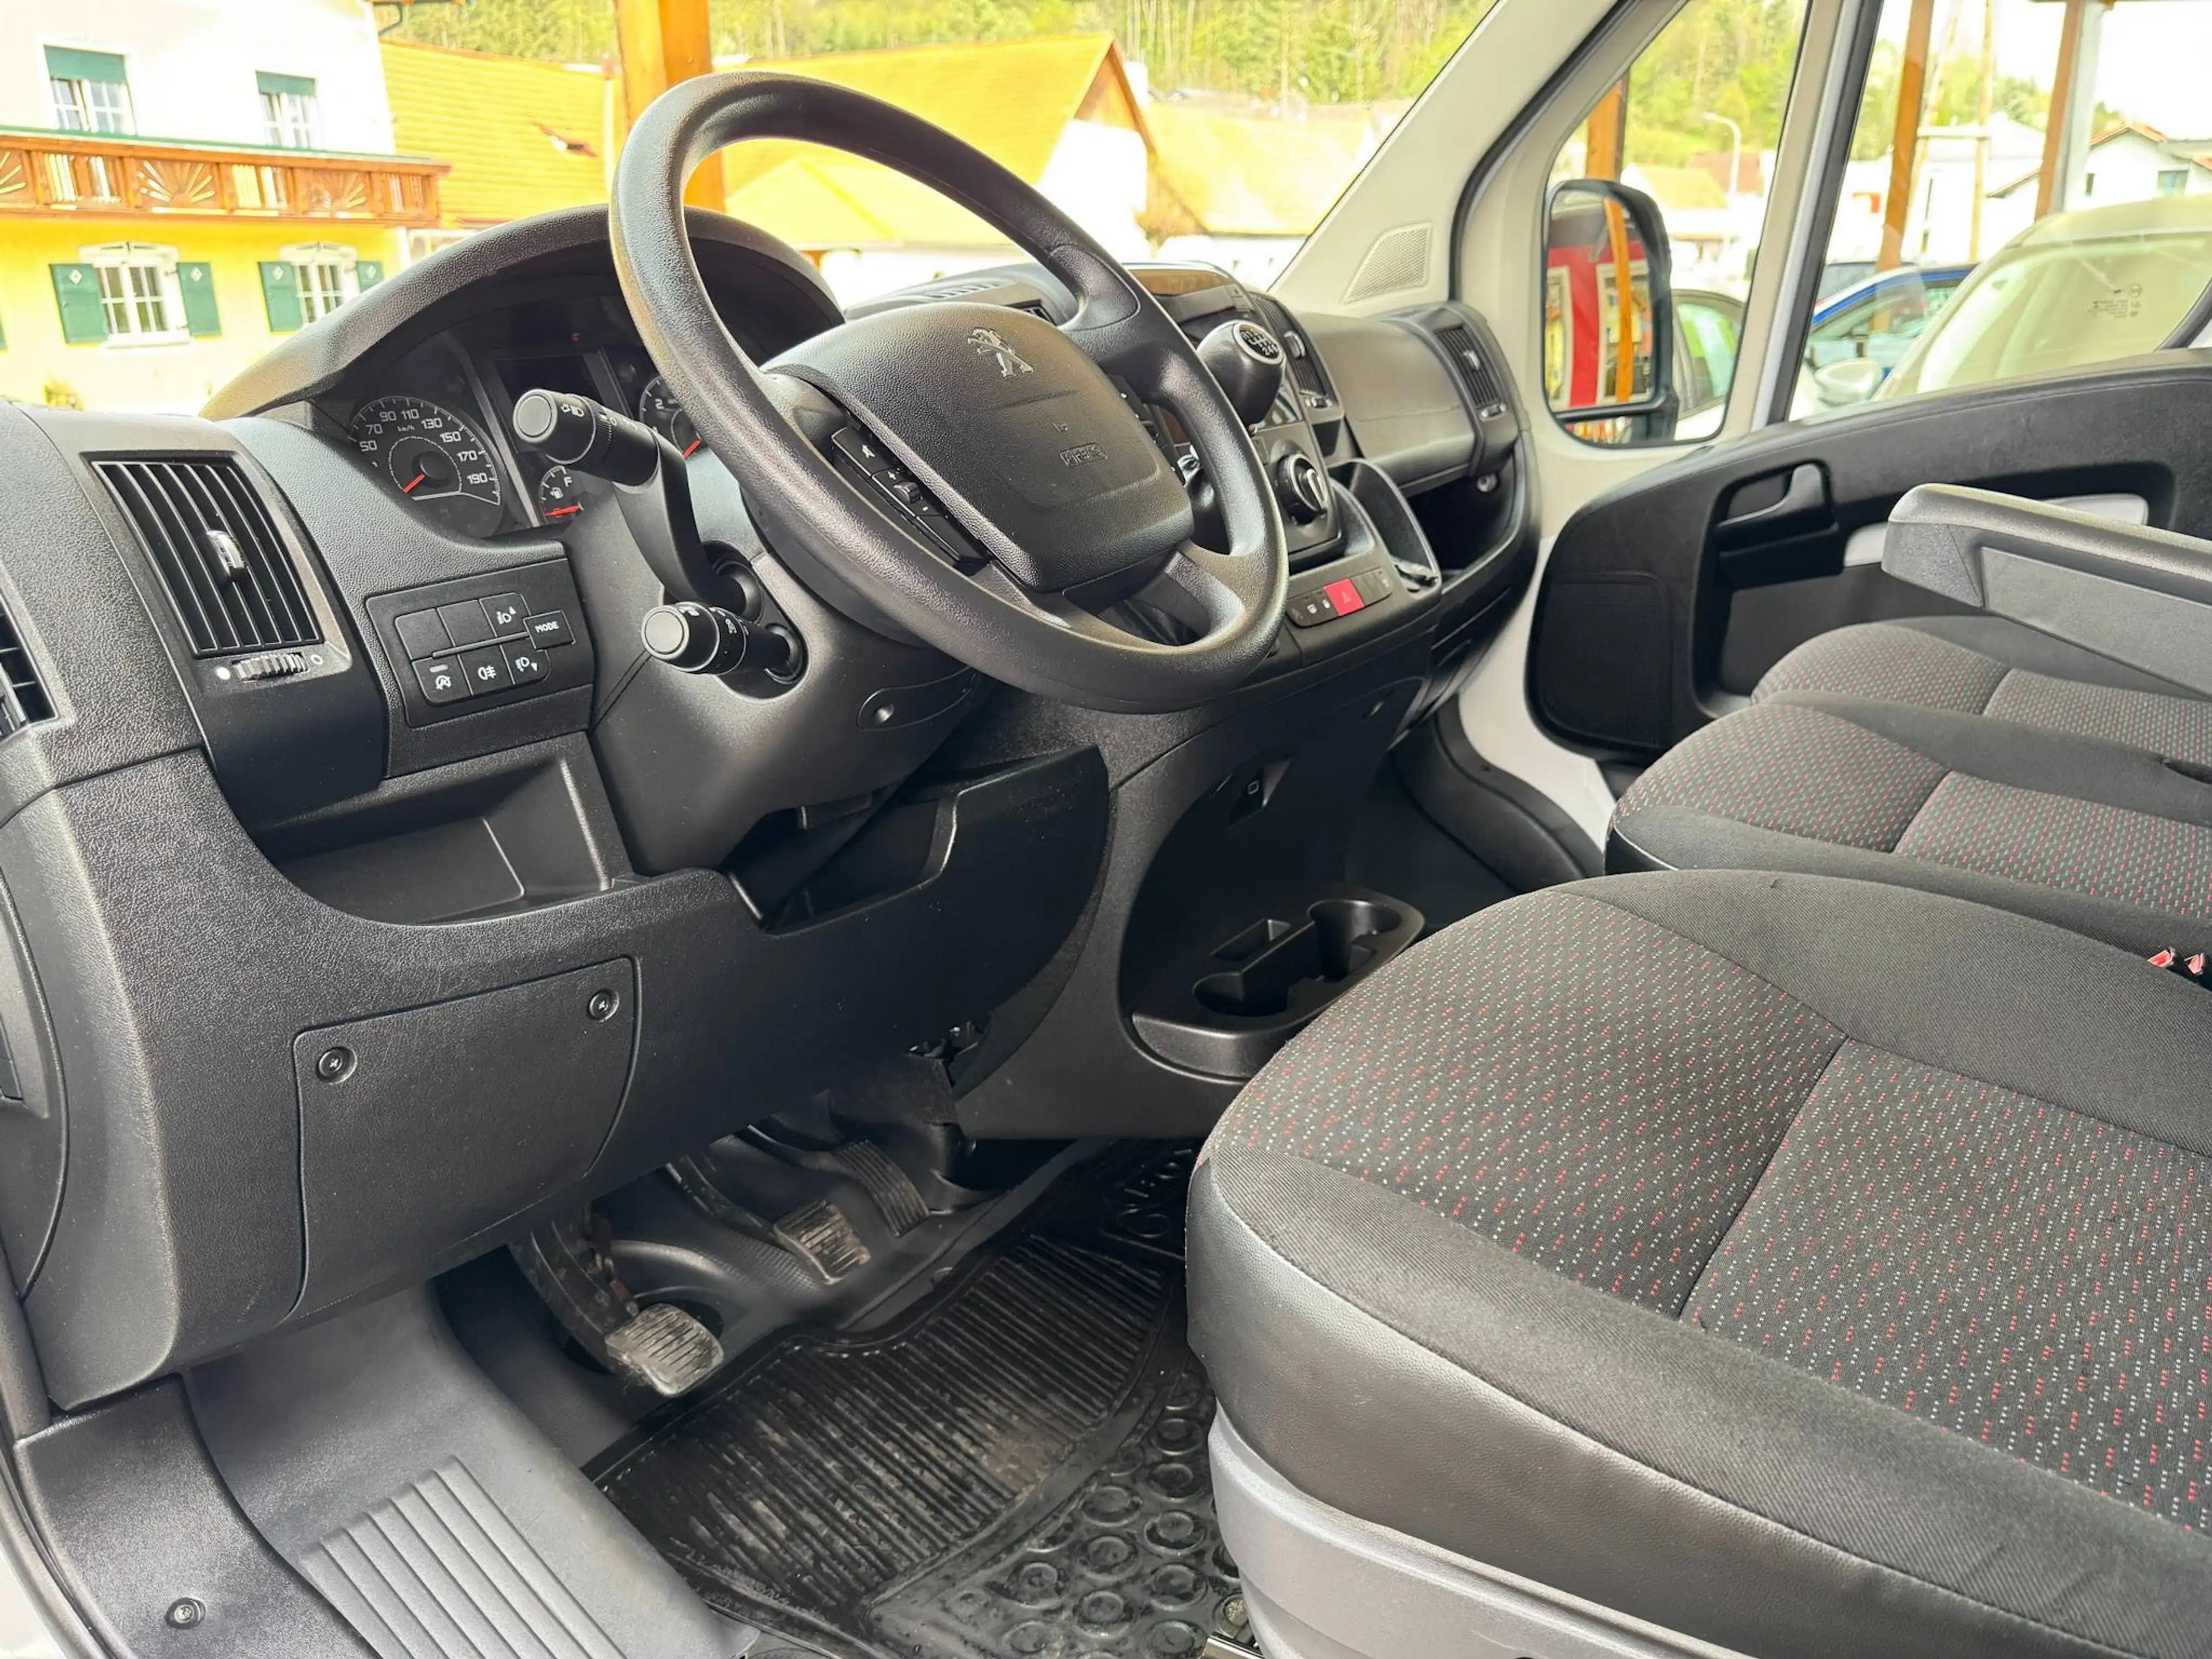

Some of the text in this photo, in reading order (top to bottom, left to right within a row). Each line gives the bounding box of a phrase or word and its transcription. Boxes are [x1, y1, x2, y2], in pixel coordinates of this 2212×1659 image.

[654, 398, 665, 410] 2
[379, 410, 397, 422] 90
[401, 408, 419, 420] 110
[365, 423, 383, 435] 70
[421, 418, 443, 429] 130
[440, 431, 461, 442] 150
[359, 440, 378, 452] 50
[456, 450, 478, 462] 170
[467, 472, 488, 484] 190
[564, 476, 573, 487] F
[535, 621, 559, 633] MODE
